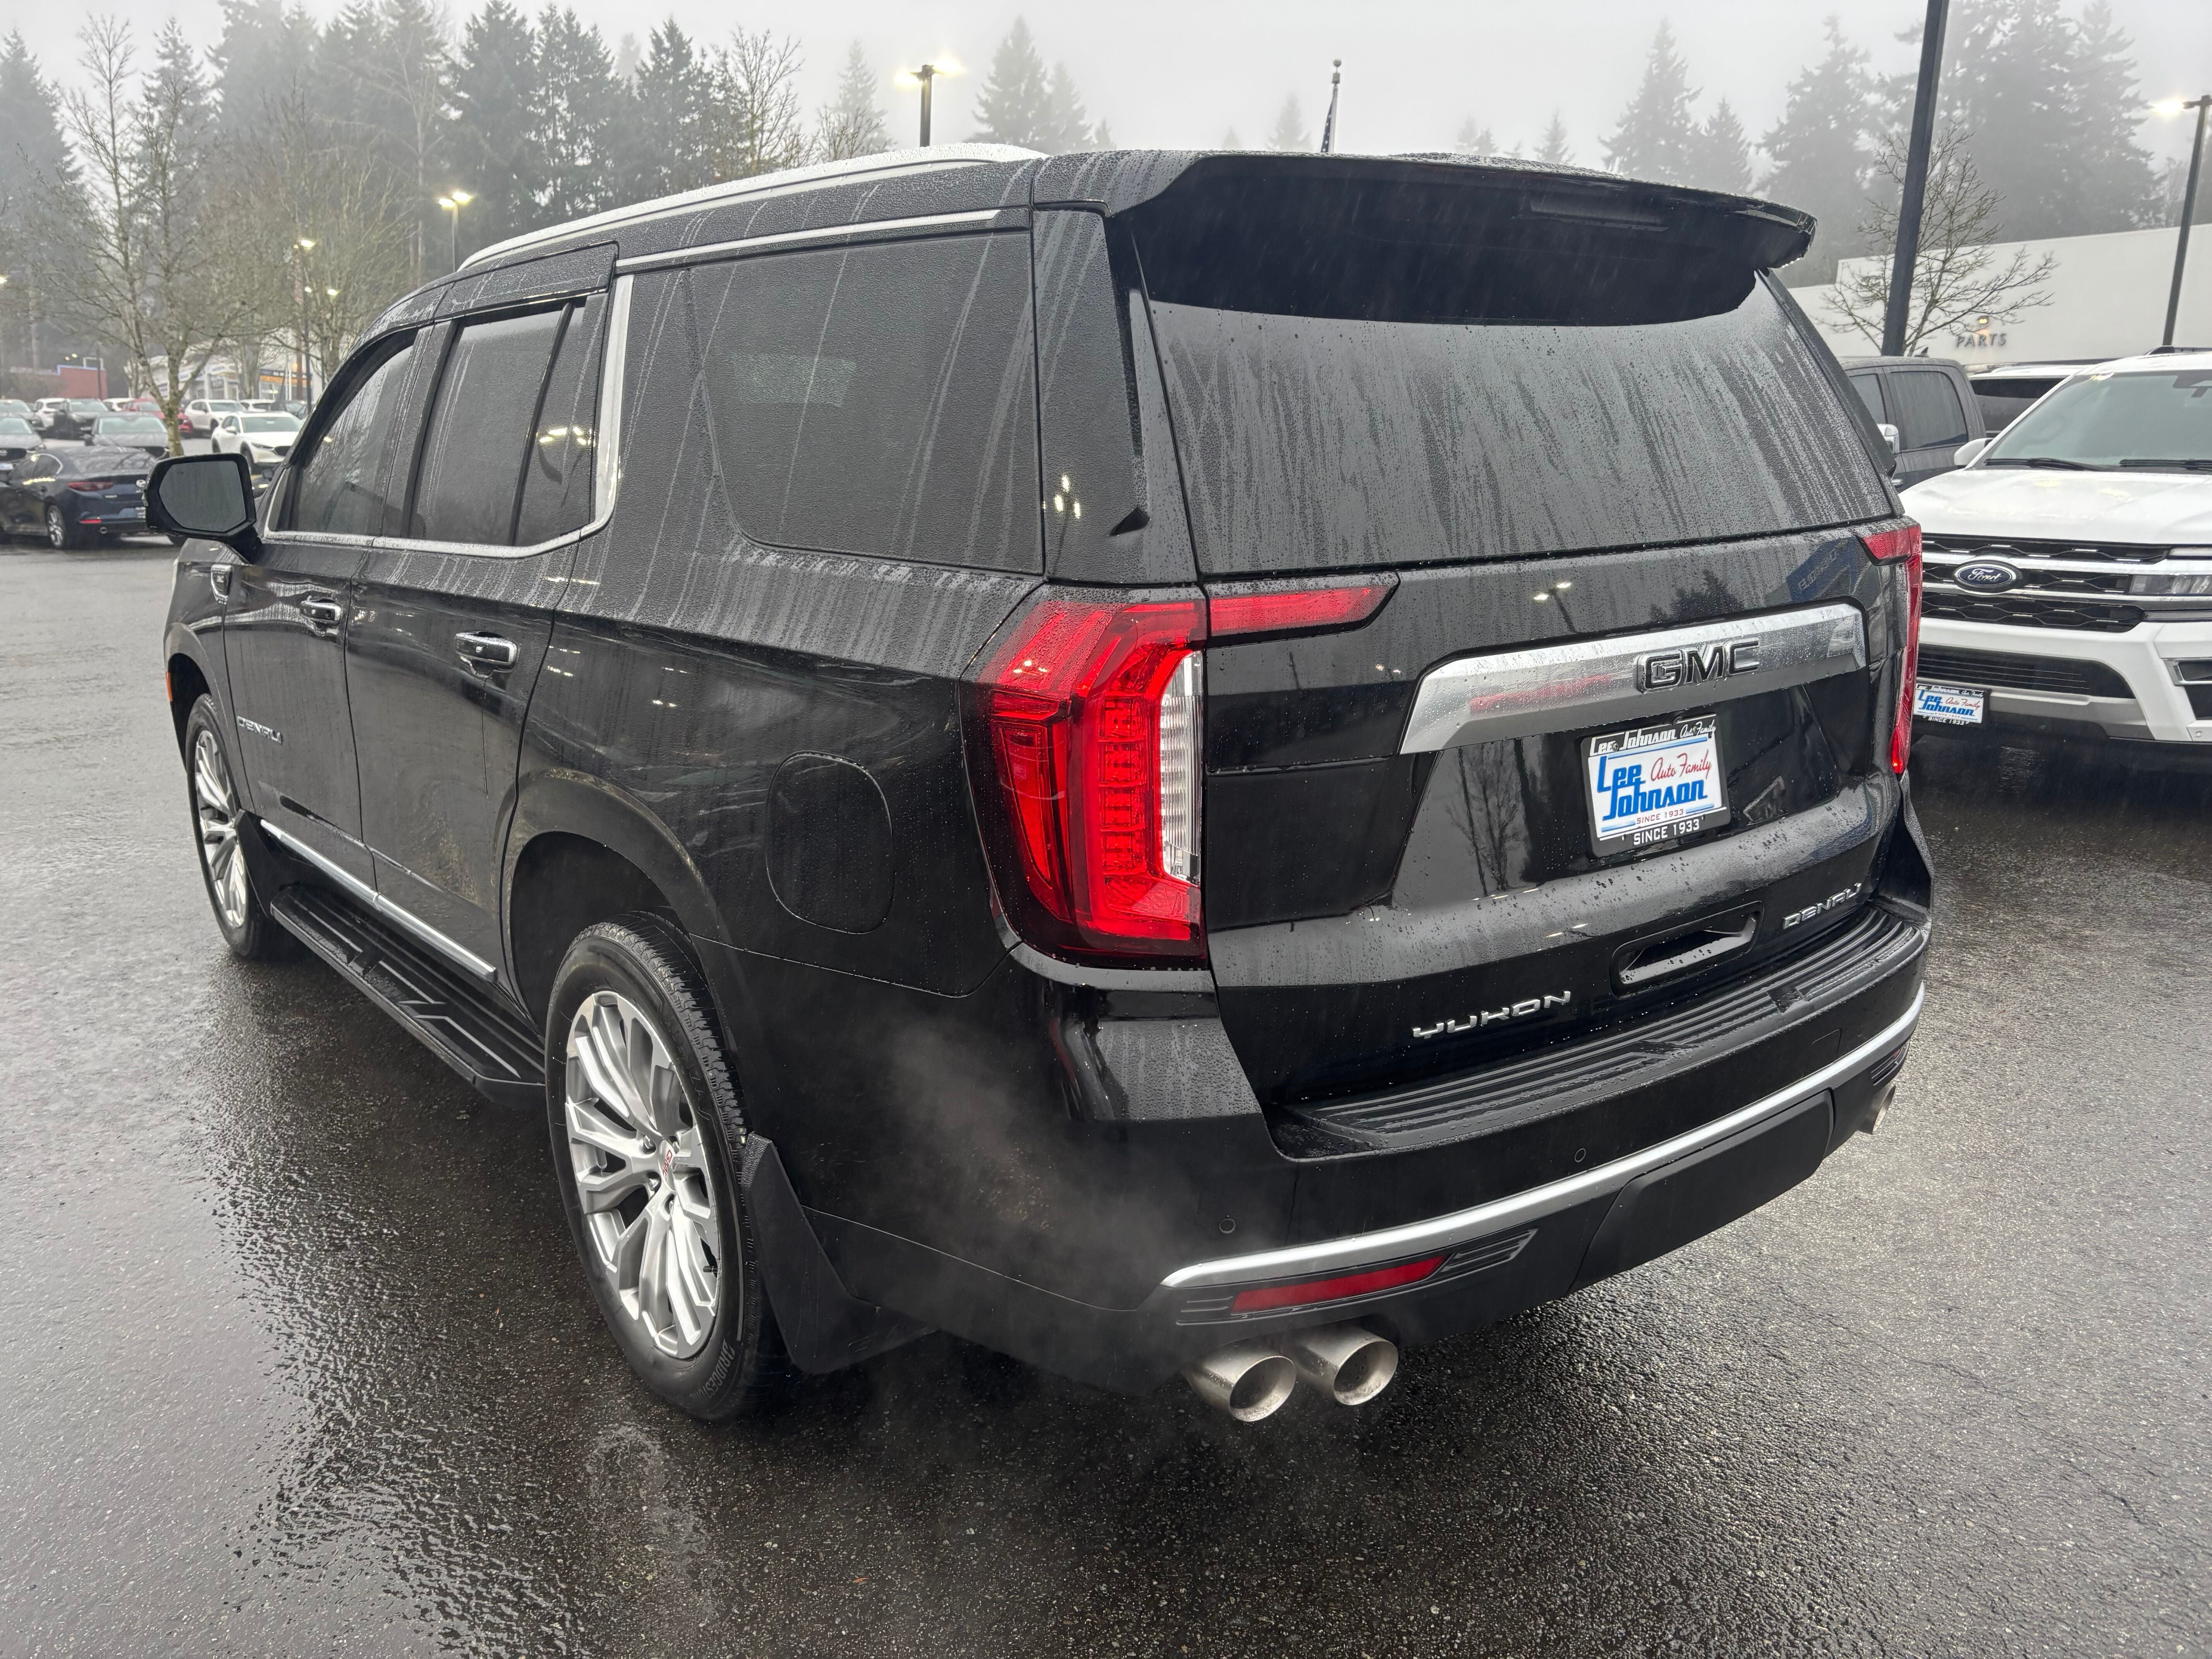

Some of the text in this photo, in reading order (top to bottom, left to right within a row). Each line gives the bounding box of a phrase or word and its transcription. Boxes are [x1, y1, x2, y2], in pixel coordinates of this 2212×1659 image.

[1956, 333, 2006, 347] PARTS
[1967, 568, 2002, 582] Ford
[1637, 637, 1760, 693] GMC
[1918, 689, 1942, 703] Lee
[1918, 700, 1975, 716] Johnson
[1961, 699, 1981, 710] Family
[237, 715, 283, 744] DENALI
[1590, 737, 1618, 756] Lee
[1619, 728, 1677, 751] Johnson
[1696, 719, 1716, 736] Family
[1597, 756, 1646, 793] Lee
[1650, 749, 1712, 781] Auto Family
[1602, 779, 1708, 821] Johnson
[1633, 818, 1700, 845] SINCE 1933
[1637, 809, 1684, 824] SINCE 1933
[1783, 883, 1862, 929] DENALI
[1412, 991, 1571, 1039] YUKON
[663, 1149, 673, 1180] GMC
